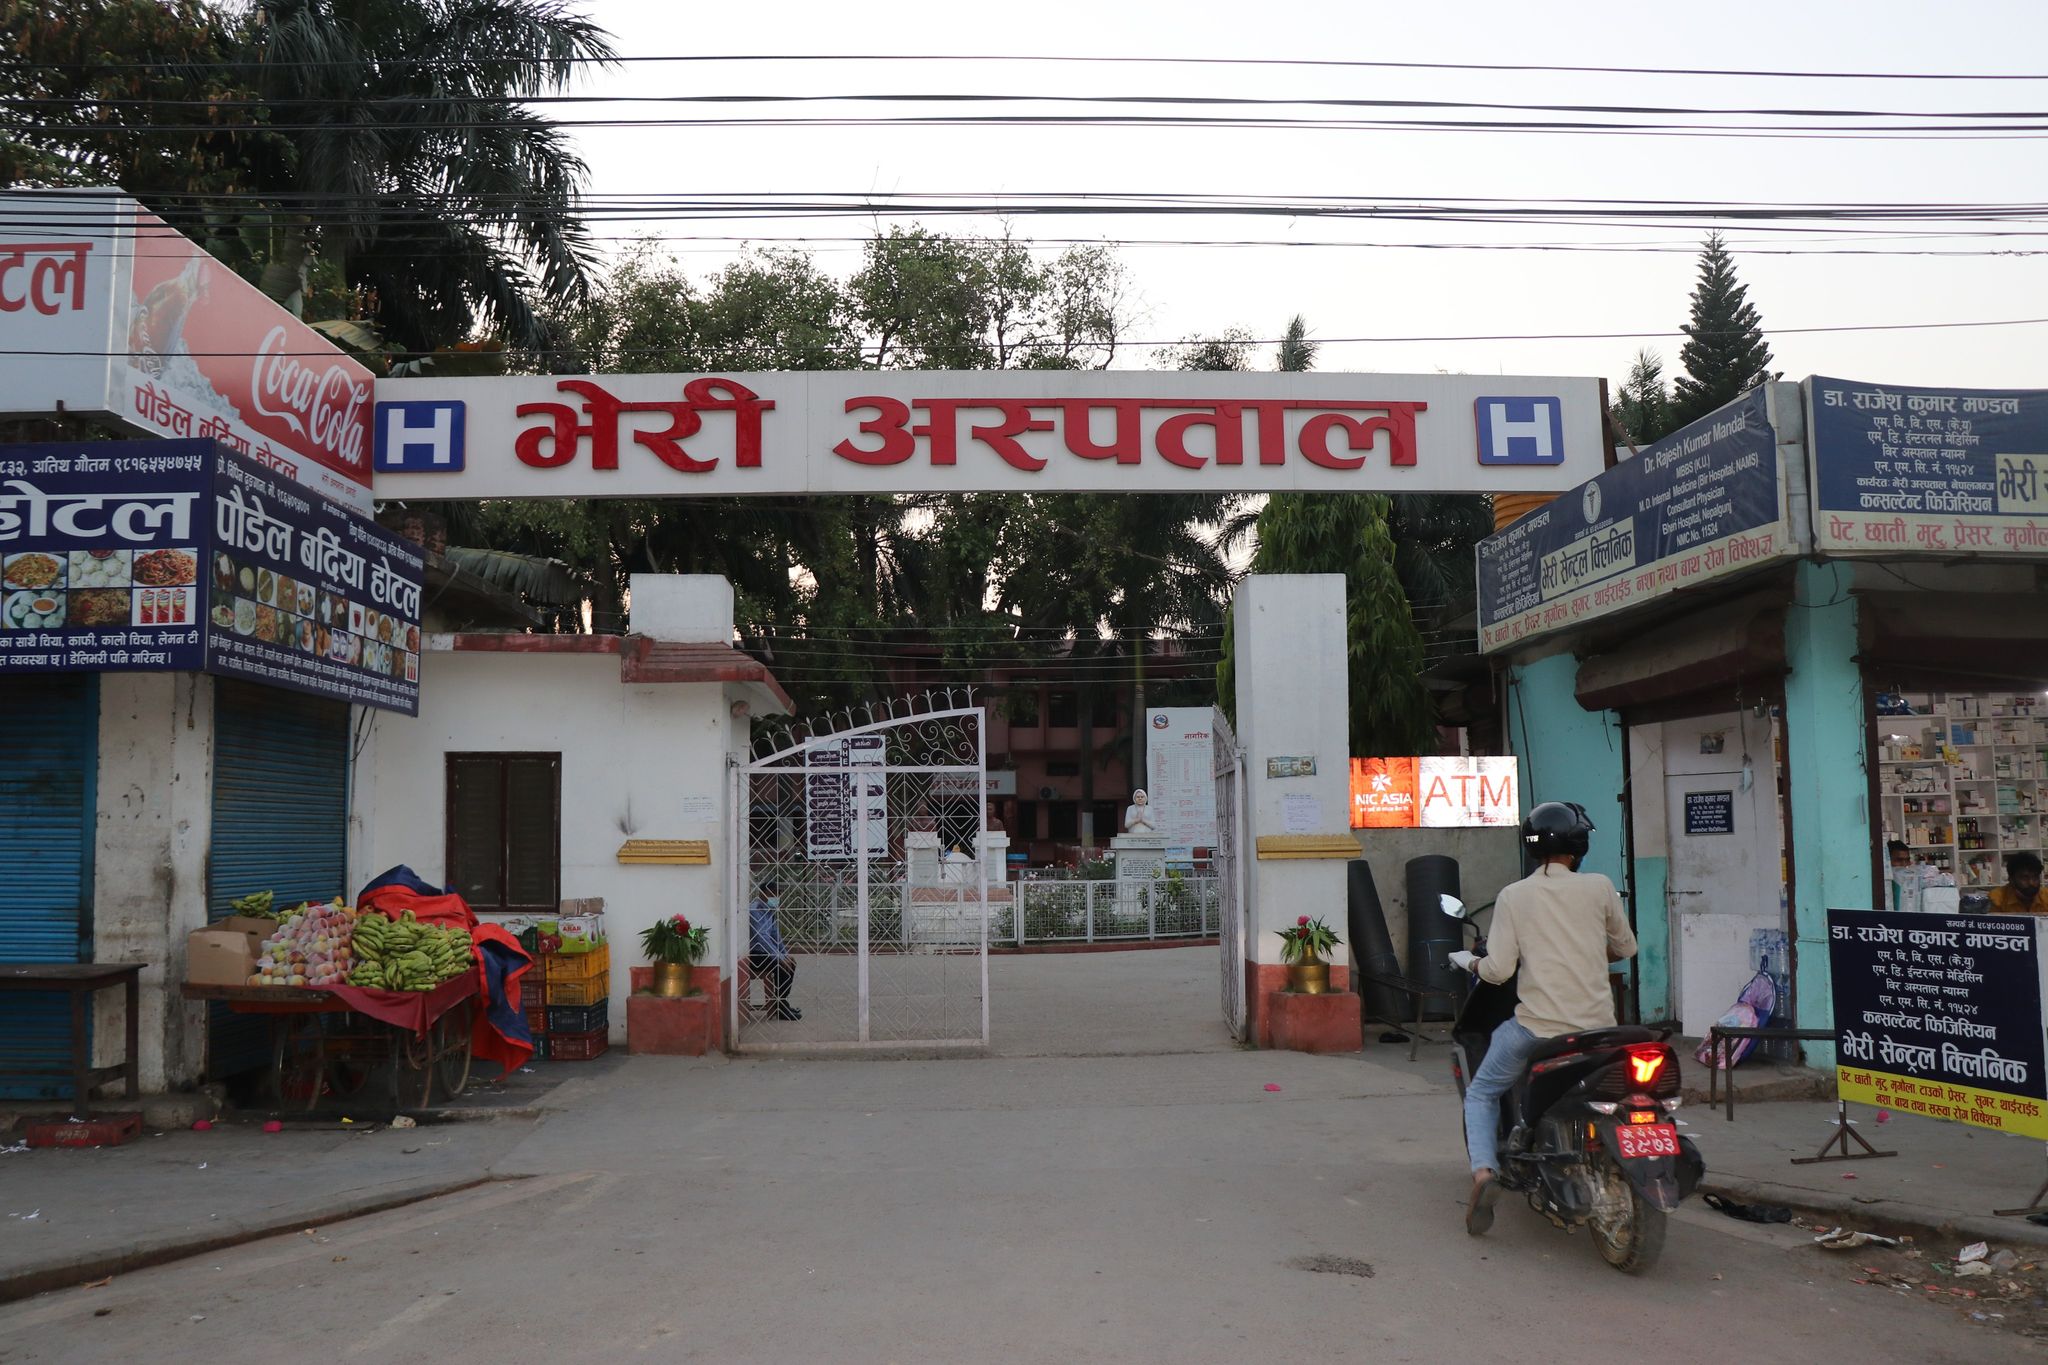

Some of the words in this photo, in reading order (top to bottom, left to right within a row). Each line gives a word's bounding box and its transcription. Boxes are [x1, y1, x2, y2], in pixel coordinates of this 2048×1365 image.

[252, 325, 371, 466] Coca-Cola
[1824, 390, 1847, 407] डा.
[1852, 388, 1901, 411] राजेश
[1907, 395, 1958, 416] कुमार
[1962, 397, 2019, 414] मण्डल
[135, 382, 193, 438] पौडेल
[1873, 416, 1890, 430] एम.
[1926, 419, 1944, 432] एस.
[387, 407, 451, 464] H
[515, 378, 776, 472] भेरी
[832, 395, 1427, 471] अस्पताल
[1489, 403, 1553, 457] H
[1867, 431, 1884, 444] एम.
[1905, 430, 1942, 445] ईन्टरनल
[1944, 431, 1980, 447] मेडिसिन
[1644, 457, 1656, 474] Dr.
[1656, 442, 1682, 469] Rajesh
[1683, 430, 1712, 456] Kumar
[1713, 411, 1746, 442] Mandal
[1902, 447, 1937, 459] अस्पताल
[74, 454, 111, 473] गौतम
[1894, 462, 1911, 475] एम.
[1945, 464, 1974, 477] ११५२४
[1673, 480, 1697, 497] Medicine
[2000, 458, 2037, 502] भेरी
[1667, 495, 1696, 516] Consultant
[1697, 486, 1725, 505] Physician
[1860, 489, 1922, 511] कन्सल्टेन्ट
[1925, 490, 1992, 512] फिजिसियन
[216, 485, 294, 562] पौडेल
[300, 527, 367, 590] बर्दिया
[371, 556, 422, 620] होटल
[1542, 556, 1558, 590] भेरी
[1560, 549, 1588, 585] सेन्ट्रल
[1590, 527, 1632, 571] क्लिनिक
[1657, 563, 1677, 585] तथा
[1704, 546, 1725, 570] रोग
[101, 632, 126, 647] कालो
[158, 631, 184, 645] लेमन
[188, 630, 199, 644] टी
[10, 654, 47, 666] व्यवस्था
[69, 651, 108, 665] डेलिभरी
[110, 652, 129, 664] पनि
[1355, 793, 1378, 805] NIC
[1380, 793, 1413, 804] ASIA
[1424, 775, 1512, 807] ATM
[1832, 925, 1853, 940] डा.
[1857, 923, 1903, 944] राजेश
[1909, 929, 1961, 949] कुमार
[1965, 933, 2030, 952] मण्डल
[1877, 950, 1893, 962] एम.
[1927, 954, 1945, 966] एस.
[1872, 965, 1888, 976] एम.
[1890, 963, 1904, 977] डि.
[1907, 965, 1943, 980] ईन्टरनल
[1946, 968, 1983, 983] मेडिसिन
[1904, 982, 1940, 995] अस्पताल
[1942, 986, 1969, 998] न्याम्स
[1897, 996, 1914, 1008] एम.
[1947, 1002, 1978, 1015] ११५२४
[1862, 1010, 1921, 1031] कन्सल्टेन्ट
[1925, 1013, 1997, 1040] फिजिसियन
[1843, 1029, 1874, 1061] भेरी
[1879, 1035, 1936, 1074] सेन्ट्रल
[1941, 1042, 2028, 1084] क्लिनिक
[1953, 1105, 1969, 1120] रोग
